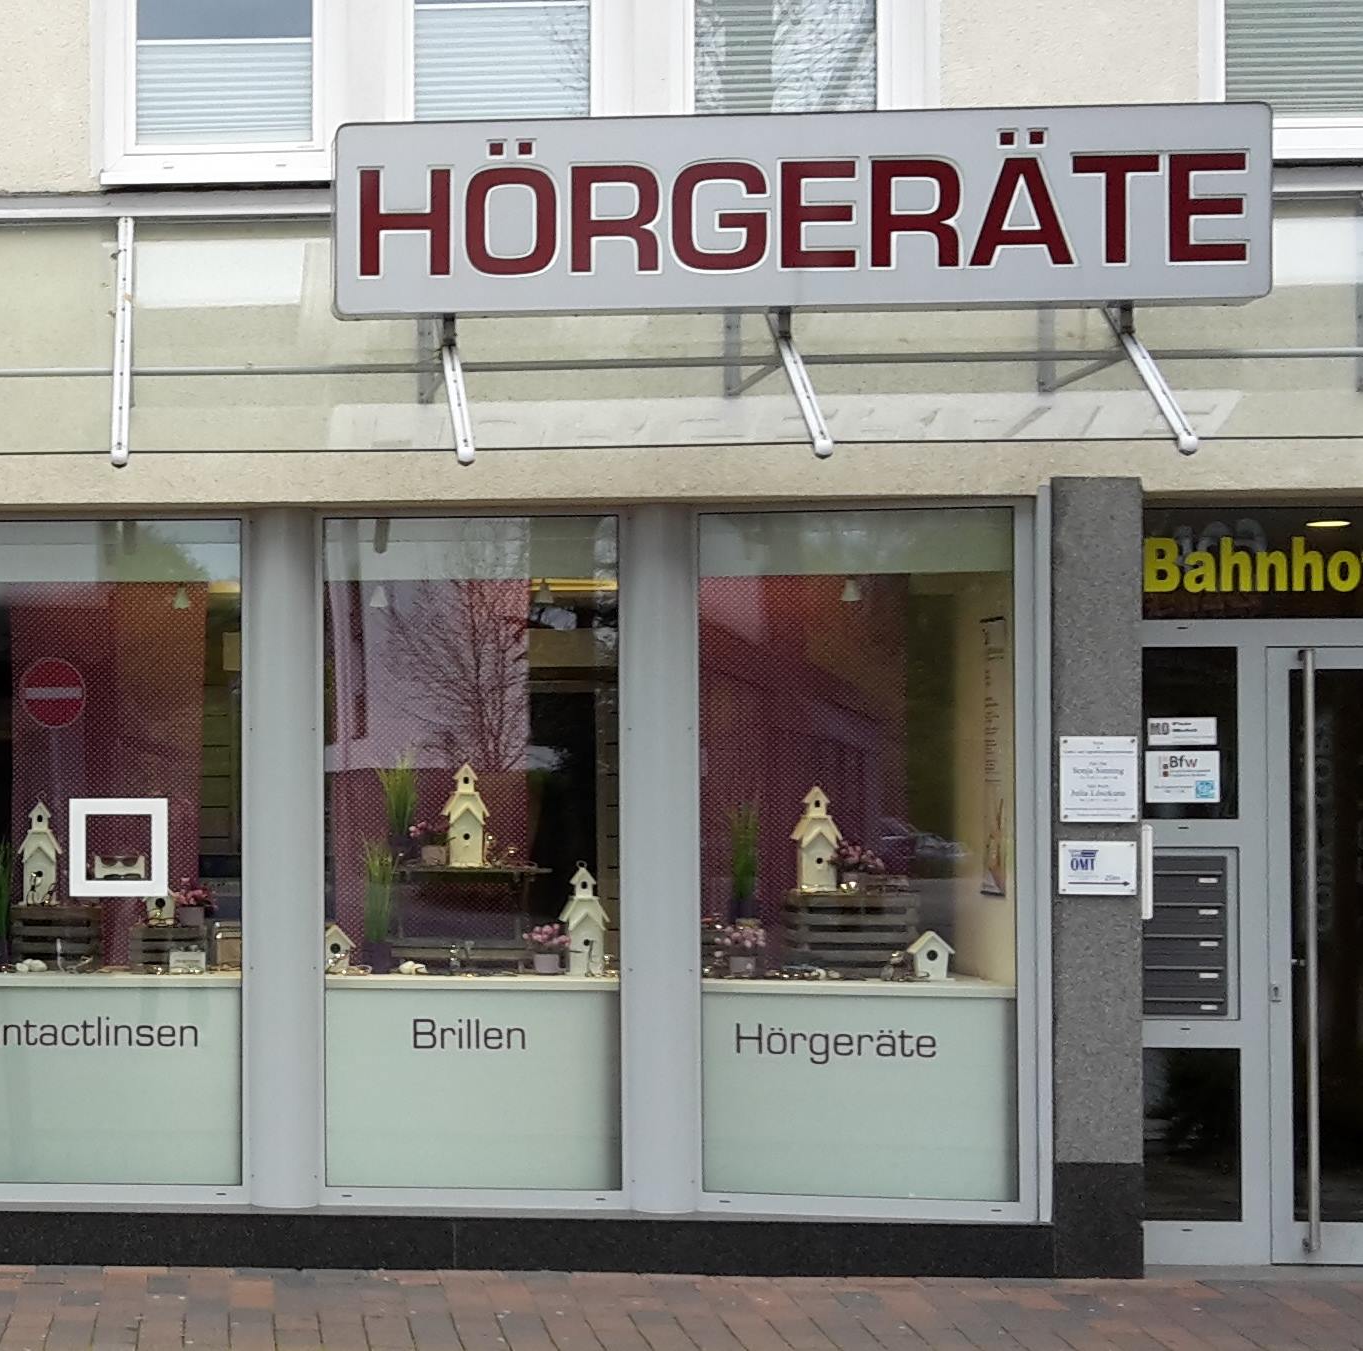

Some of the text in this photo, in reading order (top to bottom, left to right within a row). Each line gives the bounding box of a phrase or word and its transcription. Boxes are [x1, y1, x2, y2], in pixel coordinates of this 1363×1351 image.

[356, 127, 1251, 279] HÖRGERÄTE
[1143, 536, 1363, 593] Bahnho
[1169, 754, 1198, 768] Bfw
[1070, 857, 1095, 871] OMT
[412, 1017, 527, 1051] Brillen
[734, 1022, 938, 1064] Hörgeräte
